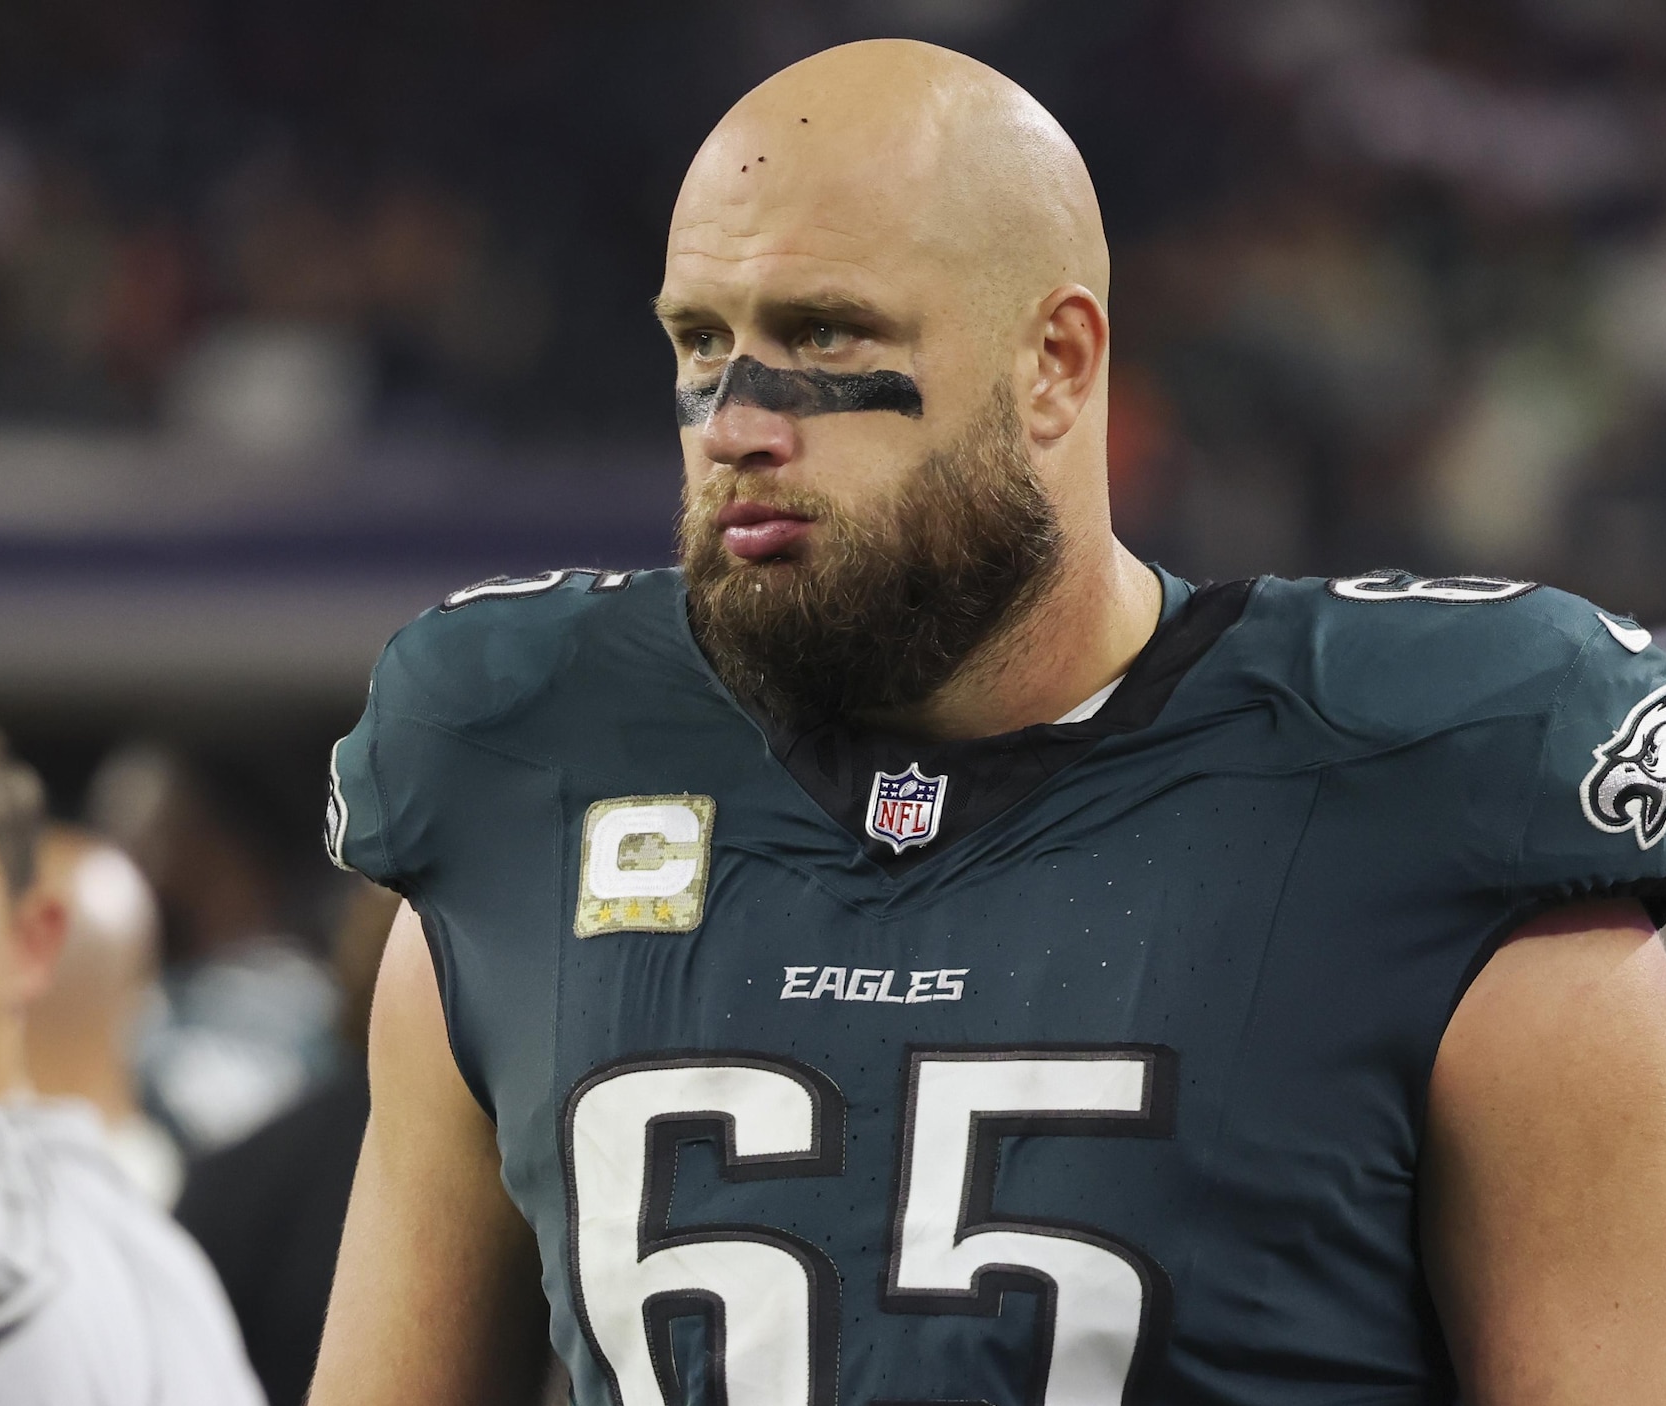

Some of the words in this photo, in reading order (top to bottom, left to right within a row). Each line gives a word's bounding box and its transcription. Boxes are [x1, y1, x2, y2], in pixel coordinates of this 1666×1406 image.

[878, 800, 927, 835] NFL
[588, 805, 701, 900] C
[780, 965, 971, 1004] EAGLES
